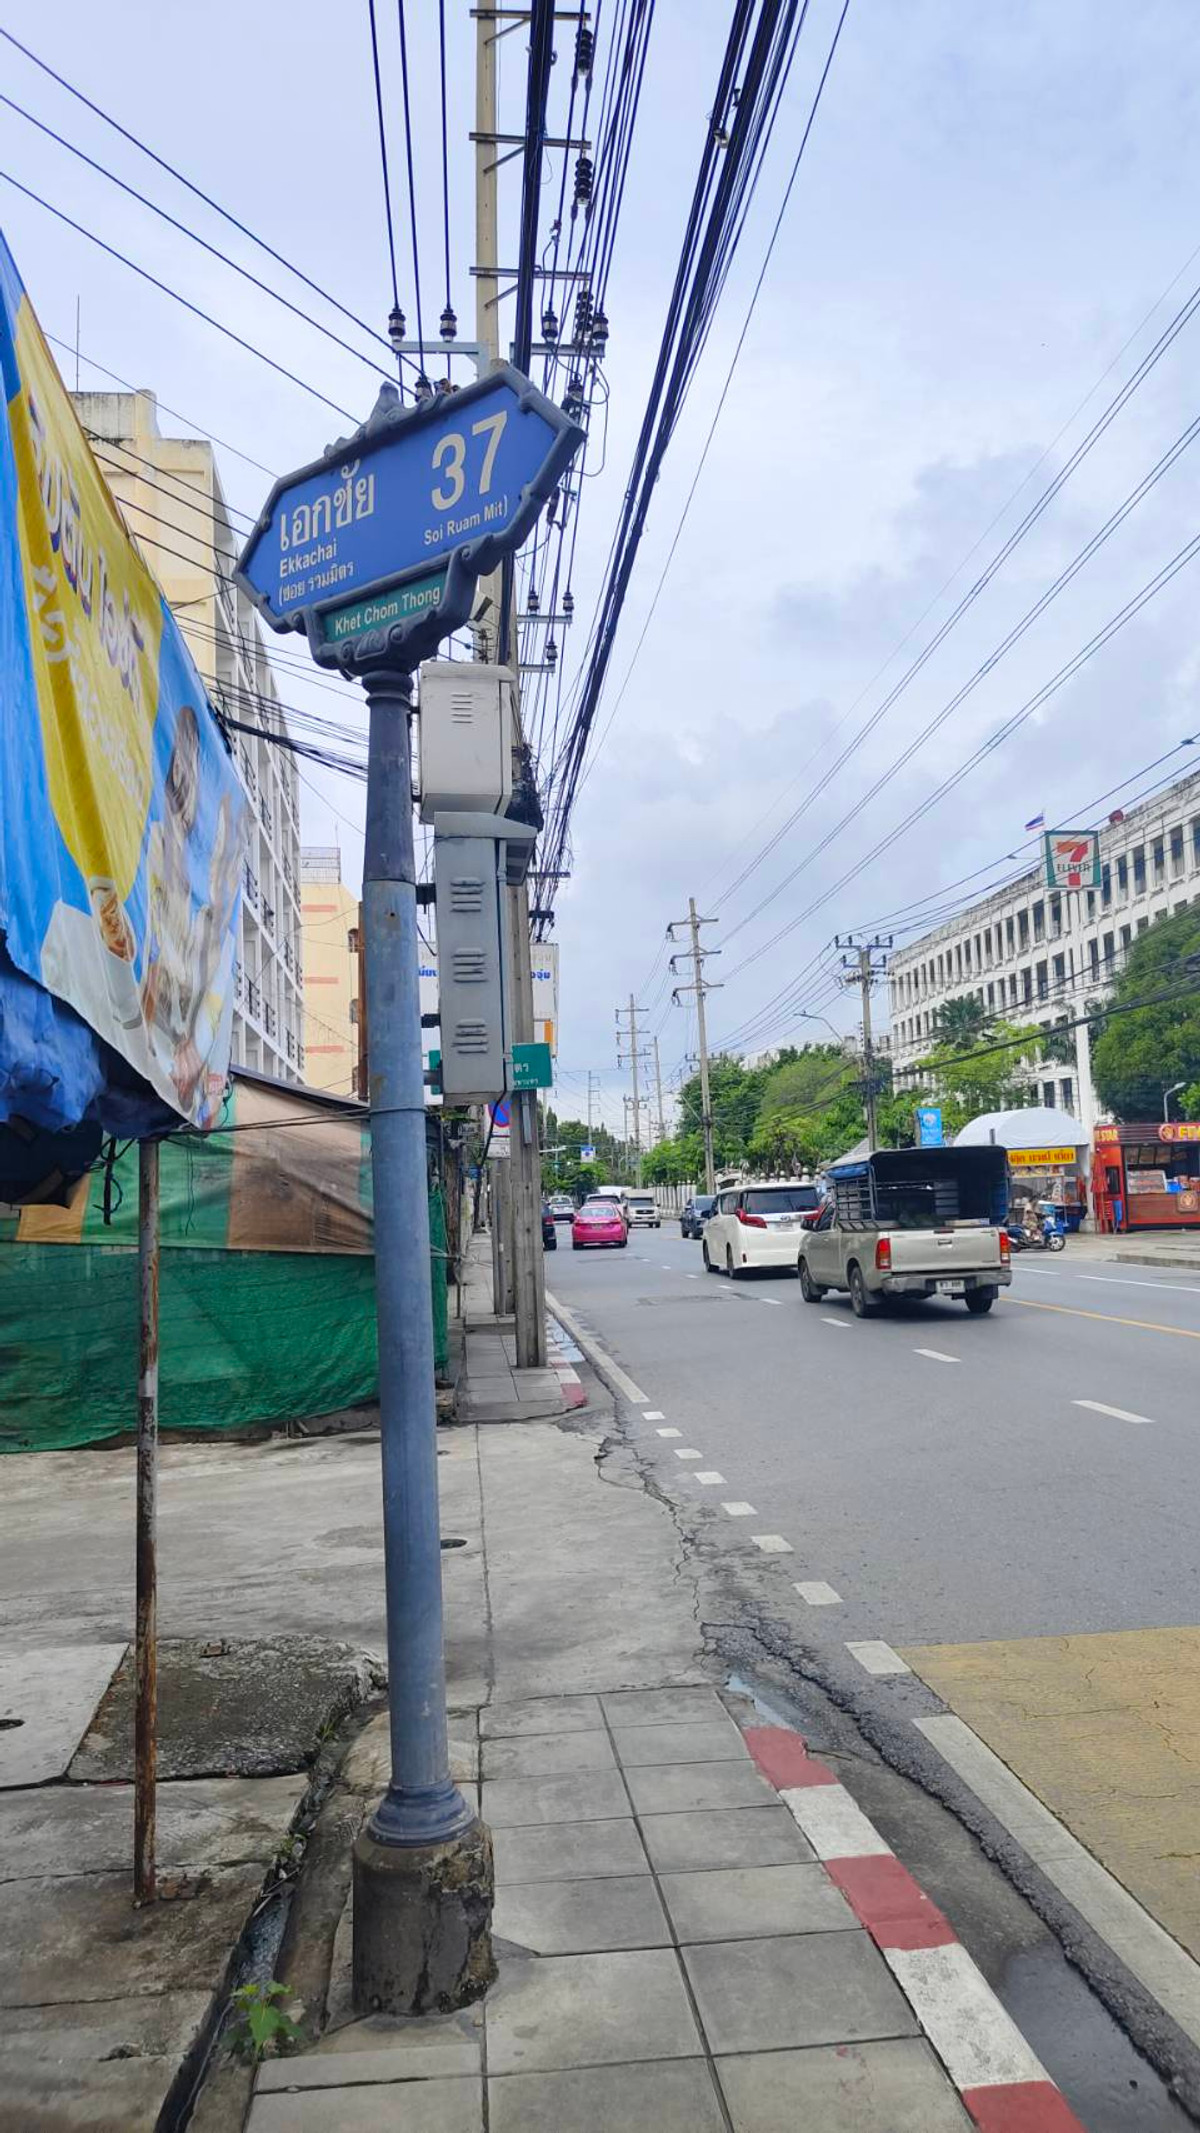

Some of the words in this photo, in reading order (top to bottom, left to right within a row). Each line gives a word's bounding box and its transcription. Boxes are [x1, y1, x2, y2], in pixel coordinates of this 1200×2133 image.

[280, 458, 375, 551] เอกชัย
[431, 410, 508, 511] 37
[423, 523, 443, 546] Soi
[447, 512, 480, 537] Ruam
[483, 495, 508, 521] Mit)
[279, 538, 337, 578] Ekkachai
[334, 611, 361, 636] Khet
[364, 602, 398, 625] Chom
[401, 586, 441, 611] Thong
[1056, 841, 1089, 887] 7
